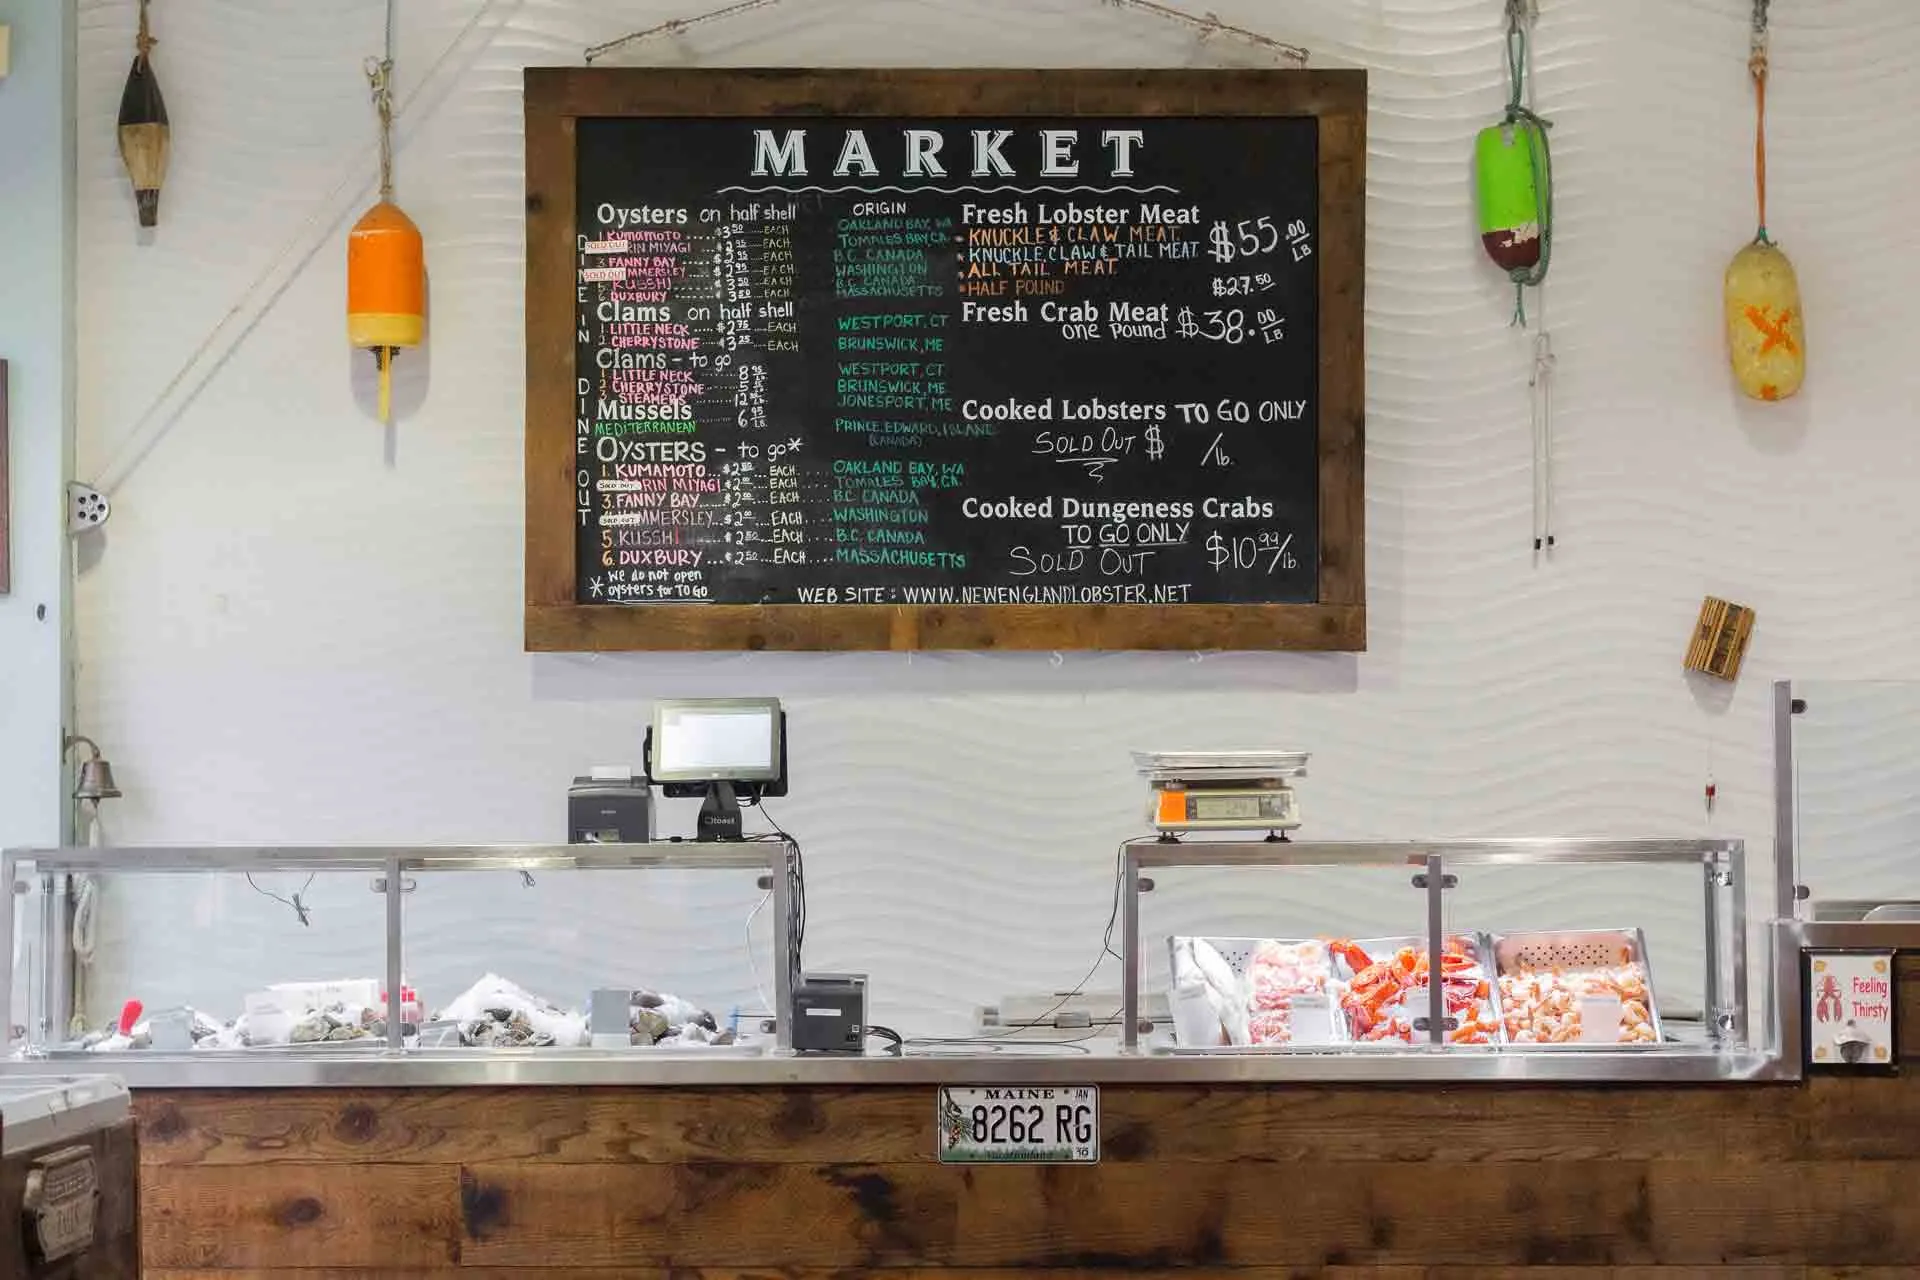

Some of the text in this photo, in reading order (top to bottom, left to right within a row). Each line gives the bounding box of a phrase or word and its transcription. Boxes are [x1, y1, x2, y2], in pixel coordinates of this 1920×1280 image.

[751, 129, 1144, 177] MARKET
[597, 203, 796, 229] Oysters on half shell
[853, 202, 906, 216] ORIGIN
[962, 203, 1200, 224] Fresh Lobster Meat
[764, 225, 789, 234] EACH
[969, 227, 1048, 247] KNUCKLE
[1068, 226, 1120, 243] CLAW
[763, 238, 791, 248] EACH
[1115, 243, 1152, 259] TAIL
[608, 251, 792, 267] FANNY BAY EACH
[1292, 244, 1312, 262] LB
[764, 264, 794, 275] EACH
[968, 262, 1000, 279] ALL
[1010, 261, 1050, 276] TAIL
[764, 276, 792, 286] EACH
[968, 280, 1065, 296] HALF POUND
[611, 288, 791, 303] DUXBURY EACH
[597, 302, 793, 322] Clams on half shell
[962, 301, 1169, 323] Fresh Crab Meat
[610, 323, 650, 336] LITTLE
[655, 323, 690, 336] NECK
[767, 321, 797, 333] EACH
[1062, 323, 1100, 340] one
[1264, 328, 1283, 344] LB
[611, 336, 799, 353] CHERRYSTONE EACH
[597, 348, 732, 373] Clams to go
[612, 370, 694, 383] LITTLE NECK
[612, 382, 705, 395] CHERRYSTONE
[618, 393, 687, 406] STEAMERS
[597, 400, 693, 420] Mussels
[962, 399, 1307, 423] Cooked Lobsters TO GO ONLY
[595, 420, 697, 438] MEDITERRANEAN
[597, 436, 706, 462] OYSTERS
[738, 441, 759, 459] to
[1032, 431, 1093, 454] SOLD
[1102, 427, 1137, 454] OUT
[615, 464, 706, 479] KUMAMOTO
[769, 464, 796, 476] EACH
[833, 460, 902, 474] OAKLAND
[673, 479, 721, 492] MIYAGI
[769, 477, 797, 489] EACH
[616, 493, 667, 509] FANNY
[671, 493, 700, 508] BAY
[770, 491, 800, 505] EACH
[862, 490, 919, 505] CANADA
[771, 510, 802, 526] EACH
[832, 508, 929, 524] WASHINGTON
[962, 496, 1273, 523] Cooked Dungeness Crabs
[619, 527, 680, 545] KUSSHI
[773, 528, 803, 544] EACH
[867, 529, 925, 545] CANADA
[1061, 521, 1192, 544] TO GO ONLY
[619, 550, 702, 566] DUXBURY
[774, 548, 806, 565] EACH
[836, 549, 966, 570] MASSACHUSETTS
[1008, 546, 1155, 576] SOLD OUT
[631, 568, 645, 581] do
[648, 568, 669, 581] not
[674, 569, 702, 584] open
[608, 583, 708, 597] oysters for TO GO
[797, 587, 838, 603] WEB
[903, 584, 1192, 604] WWW.NEWENGLANDLOBSTER.NET
[1853, 976, 1888, 998] Feeling
[1852, 1001, 1888, 1023] Thirsty
[985, 1089, 1089, 1100] MAINE JAN
[972, 1105, 1091, 1144] 8262 RG
